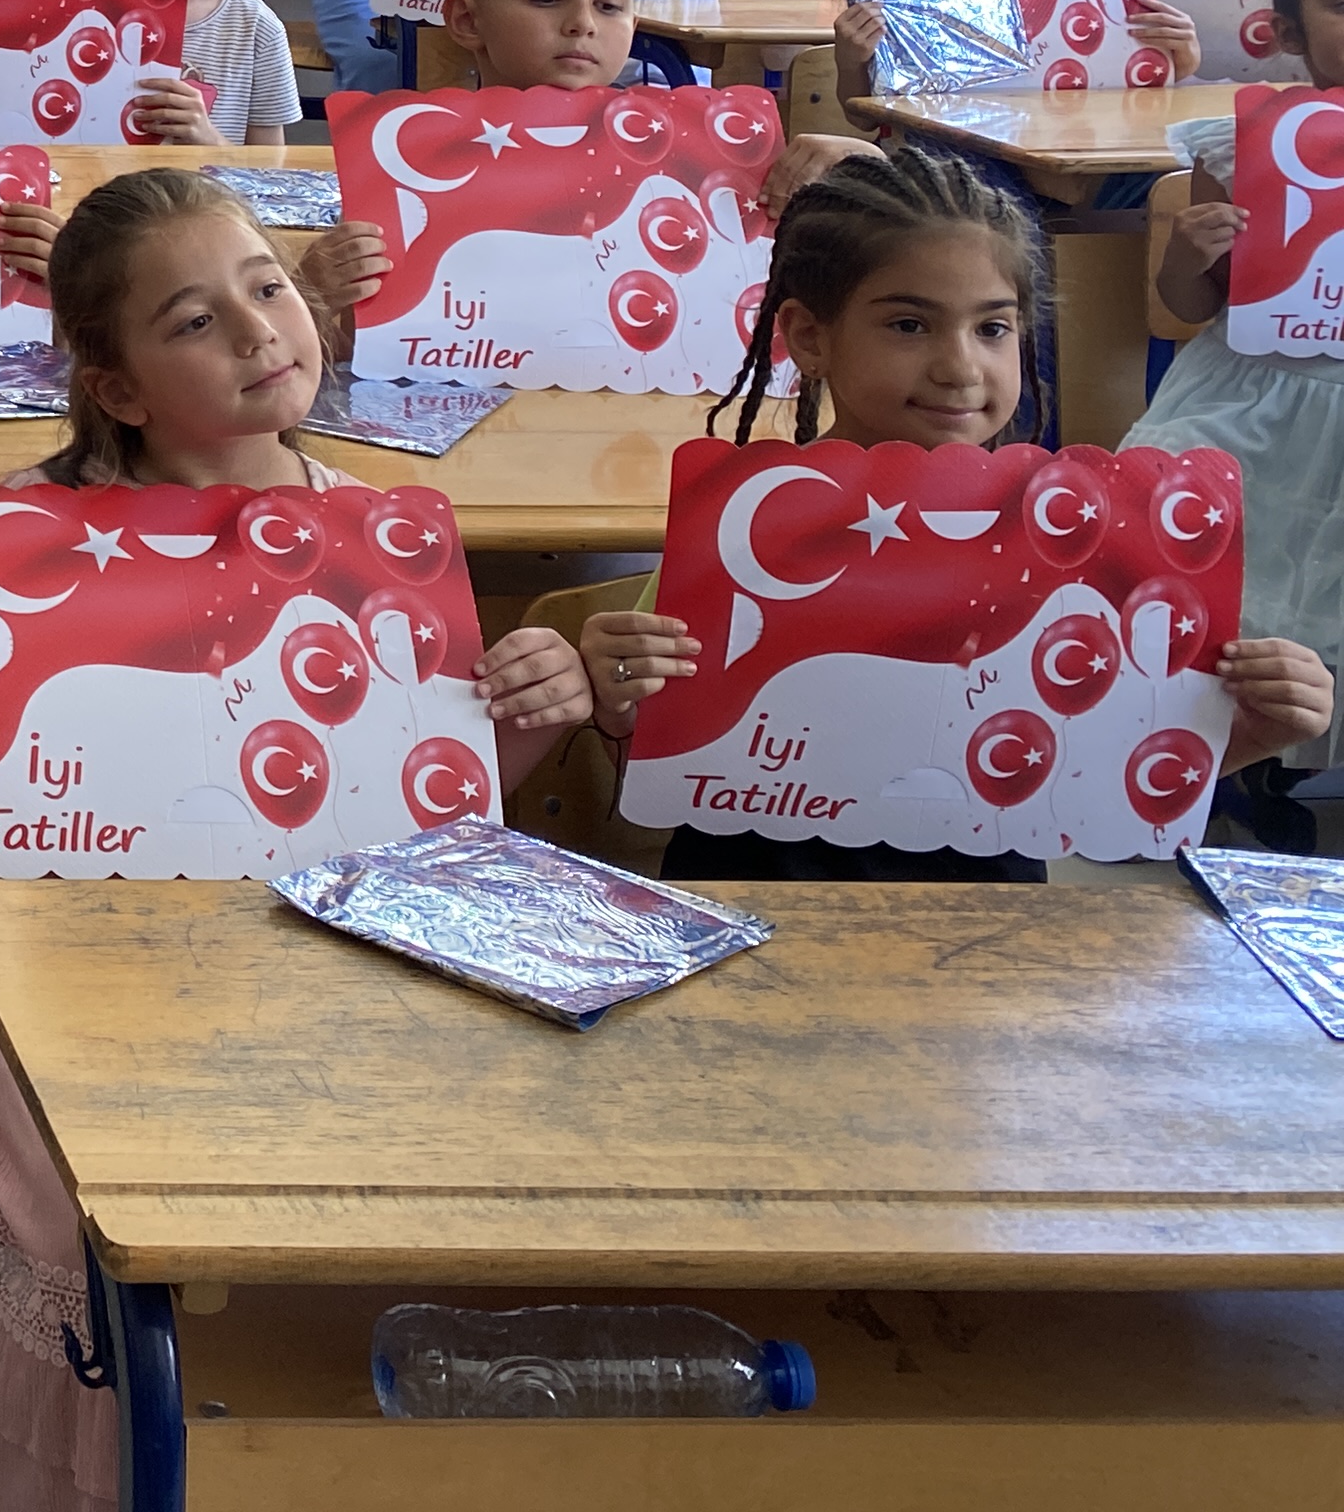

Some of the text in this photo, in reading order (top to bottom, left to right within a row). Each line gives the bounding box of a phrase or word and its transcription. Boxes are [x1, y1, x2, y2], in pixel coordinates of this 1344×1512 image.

[442, 281, 486, 330] İyi
[1313, 267, 1344, 310] İy
[1269, 314, 1344, 342] Tatil
[400, 337, 534, 371] Tatiller
[28, 732, 84, 799] İyi
[747, 713, 810, 772] İyi
[683, 775, 857, 821] Tatiller
